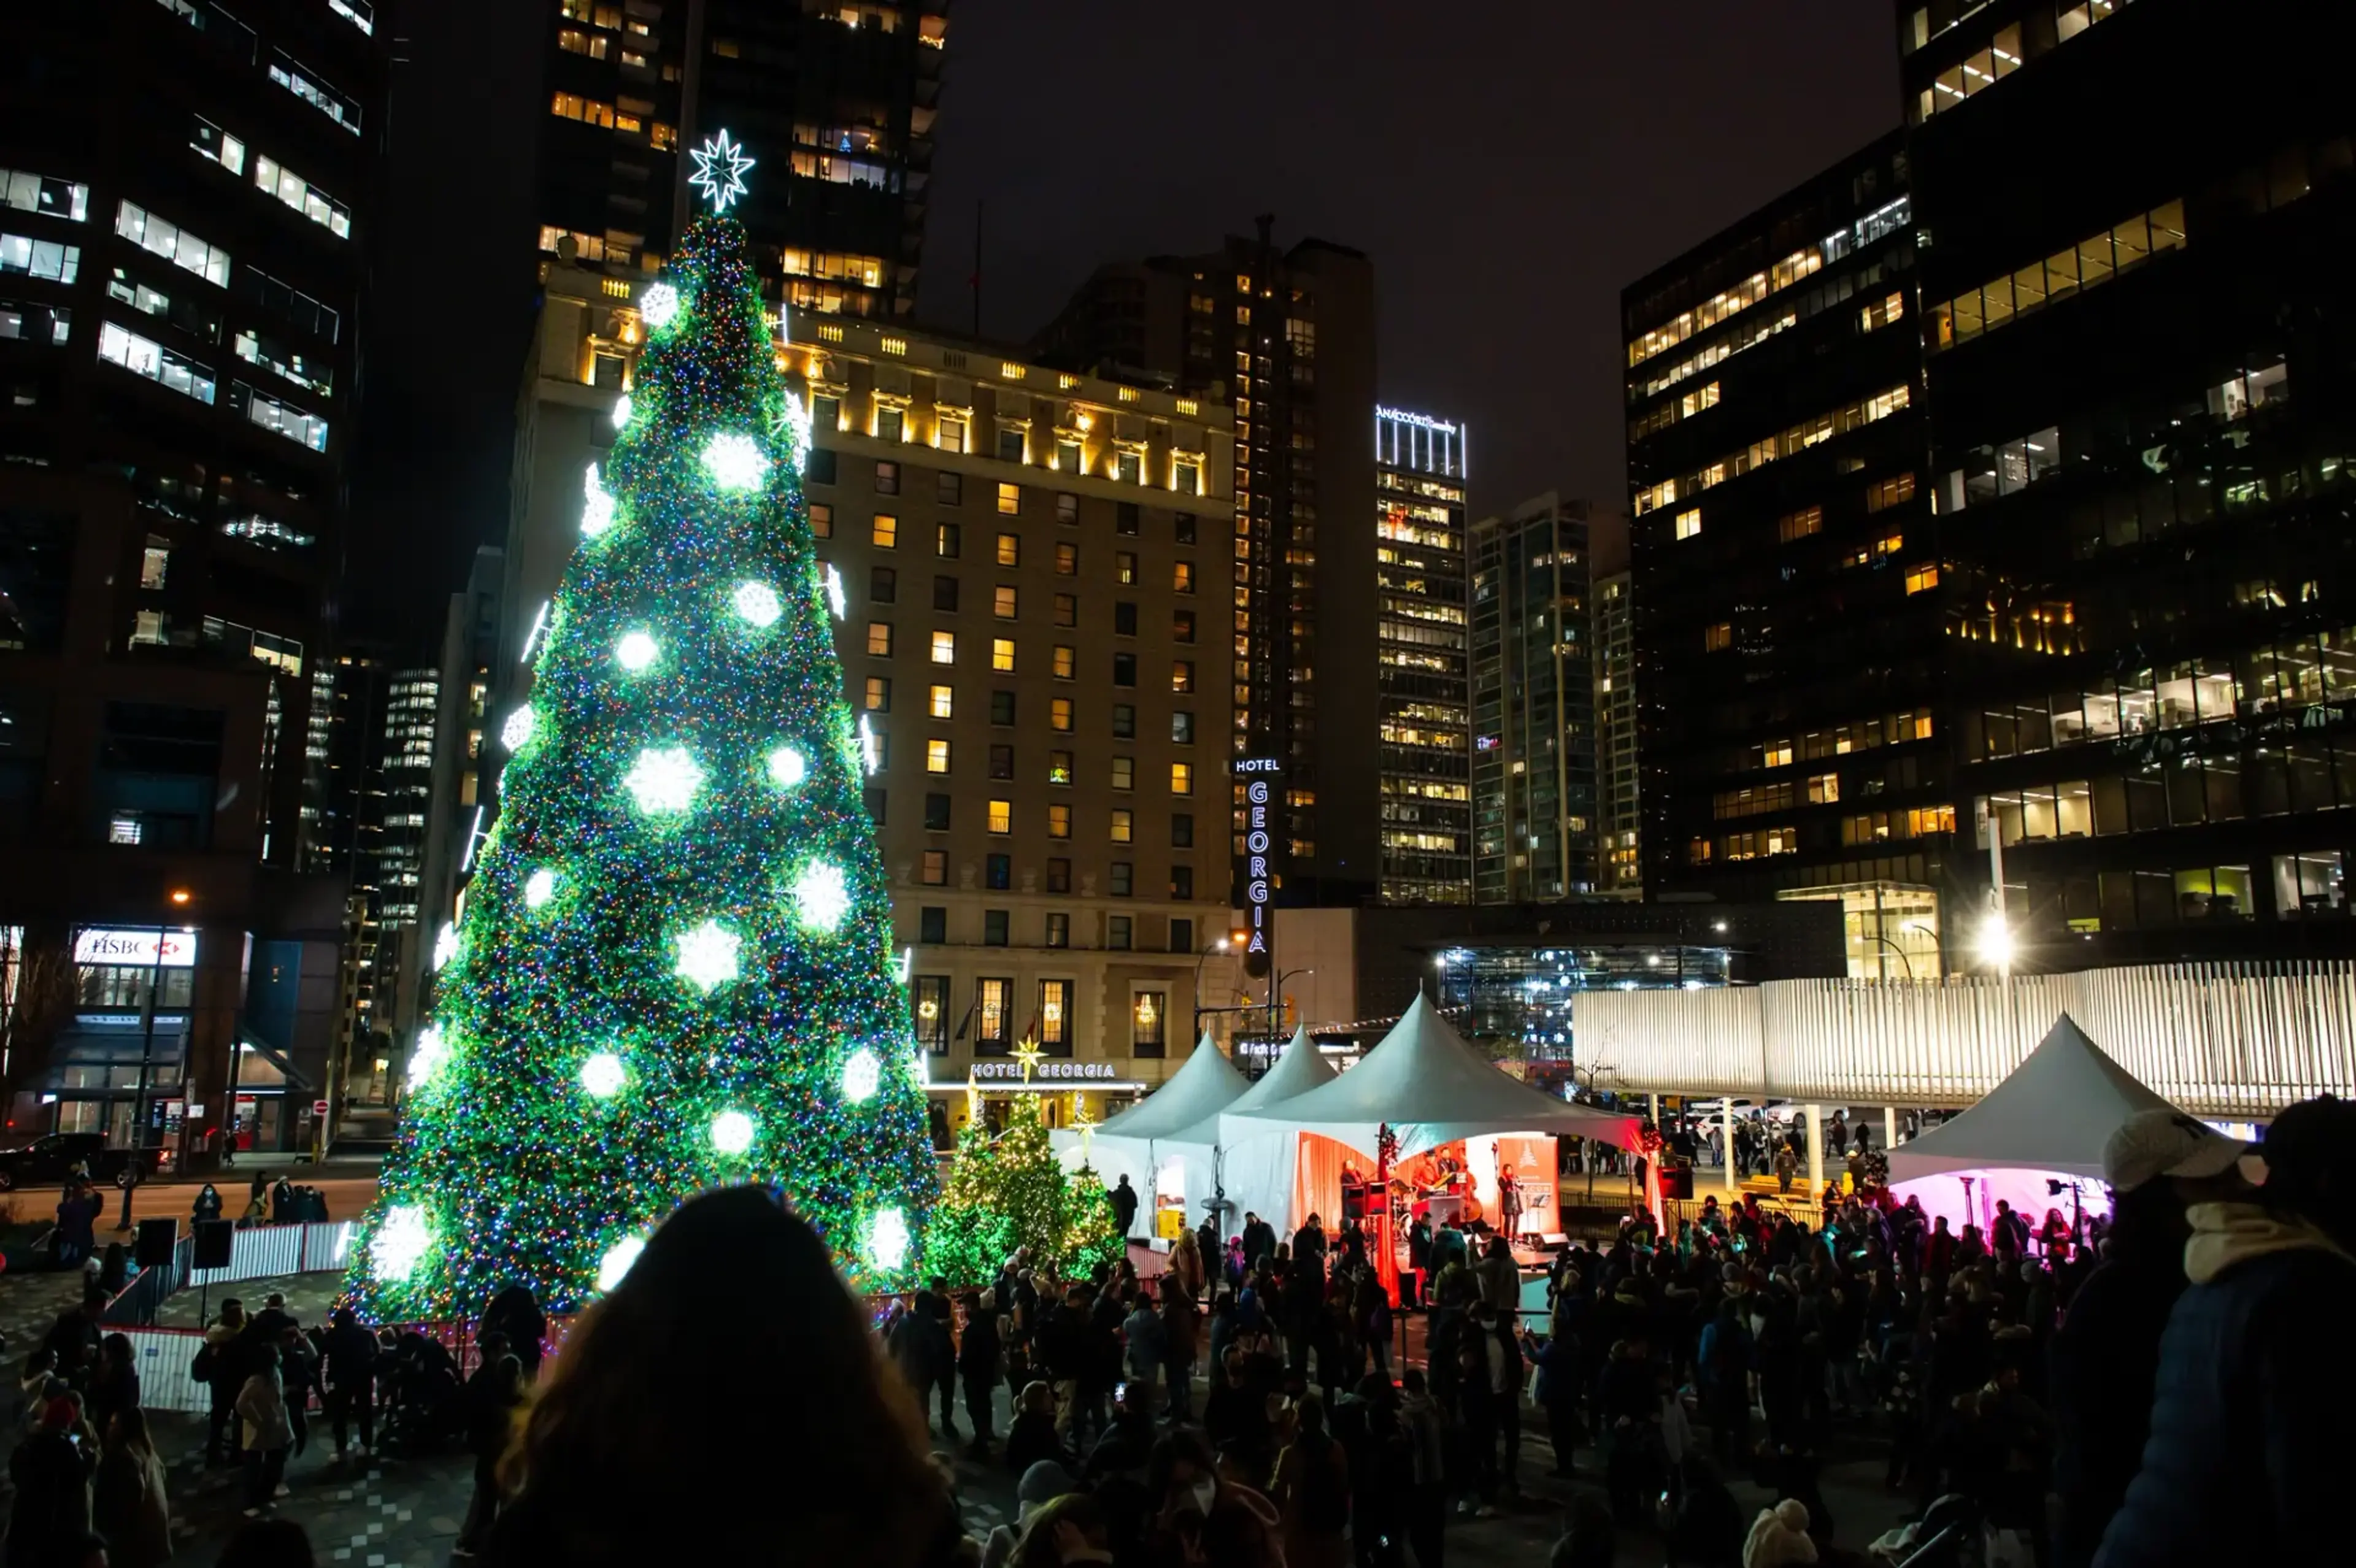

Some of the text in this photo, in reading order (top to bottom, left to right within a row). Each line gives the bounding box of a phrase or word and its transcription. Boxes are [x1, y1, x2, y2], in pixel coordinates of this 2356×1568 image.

[1236, 759, 1279, 772] HOTEL
[1249, 781, 1268, 953] GEORGIA
[93, 939, 149, 955] HSBC
[971, 1064, 1115, 1077] HOTEL GEORGIA
